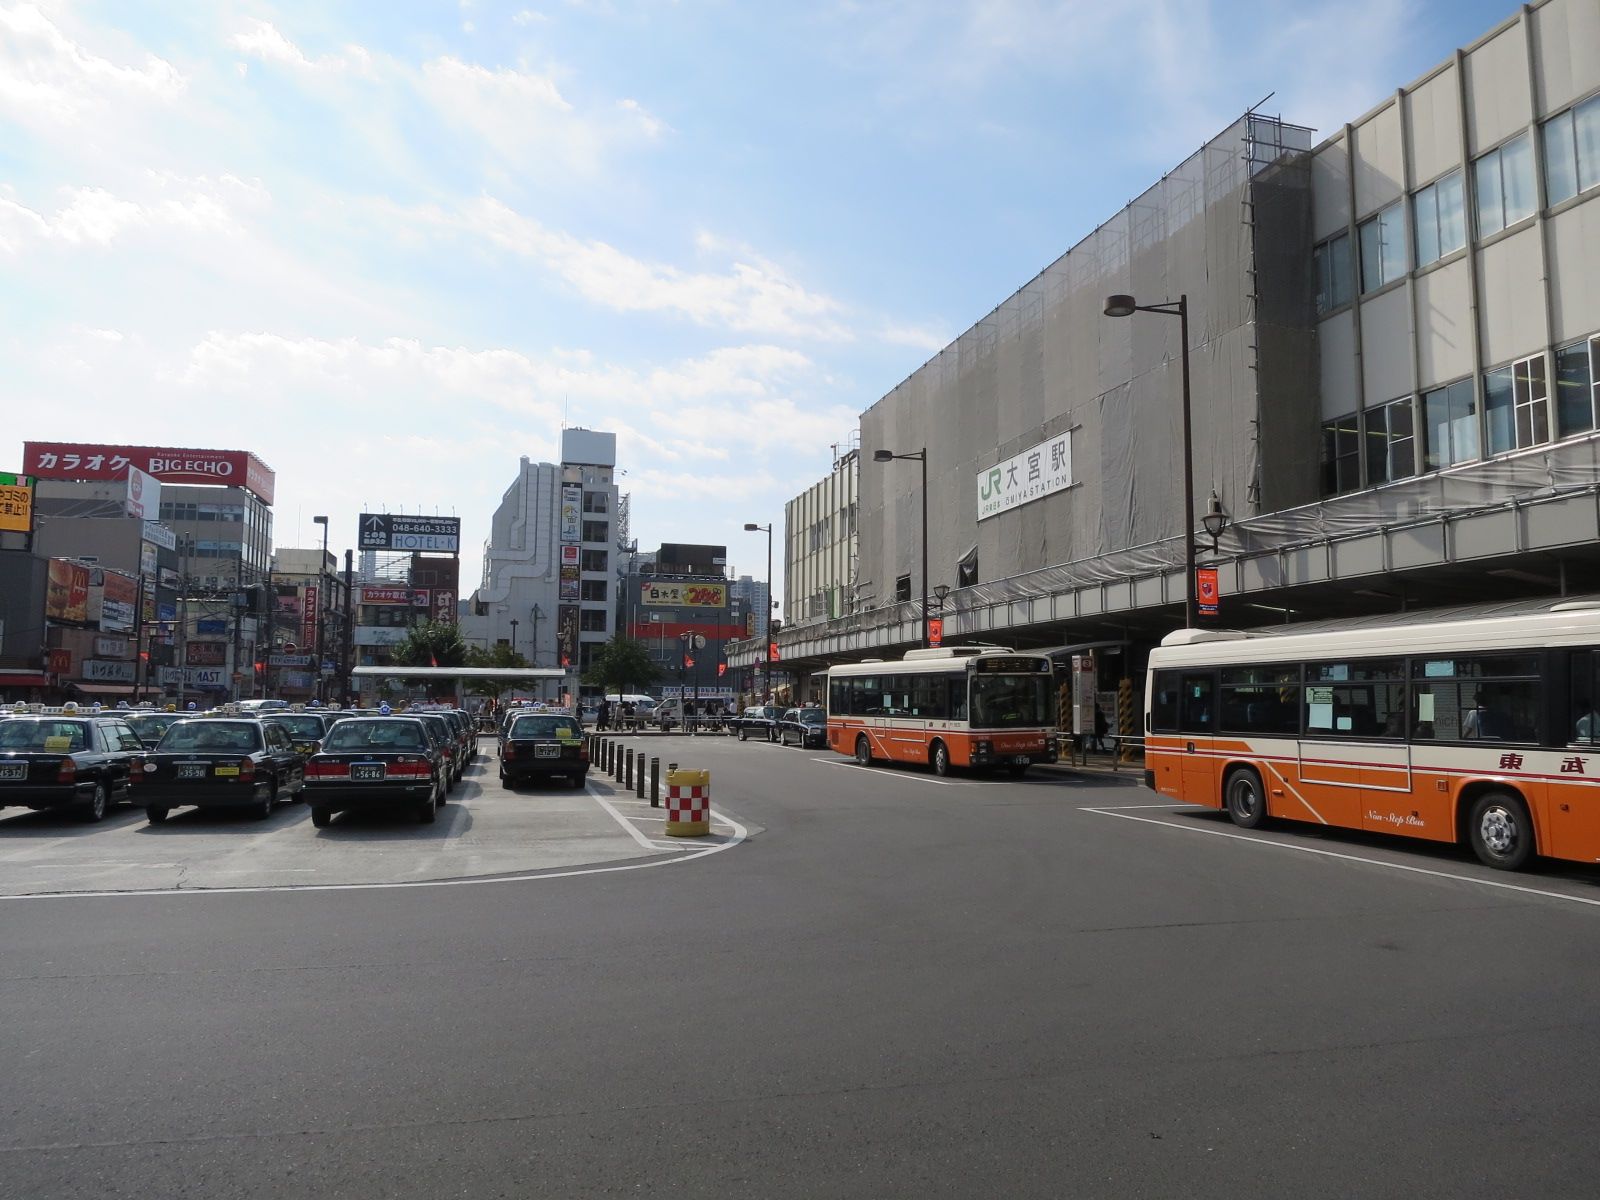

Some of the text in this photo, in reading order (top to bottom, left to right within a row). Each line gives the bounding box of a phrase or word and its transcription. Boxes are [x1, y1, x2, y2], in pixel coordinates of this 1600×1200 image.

[37, 452, 130, 471] カラオケ
[149, 458, 233, 476] BIG ECHO
[981, 440, 1066, 501] JR 大宮駅
[392, 524, 457, 534] 048-640-3333
[306, 589, 315, 617] カラオケ
[1406, 815, 1425, 827] Bus
